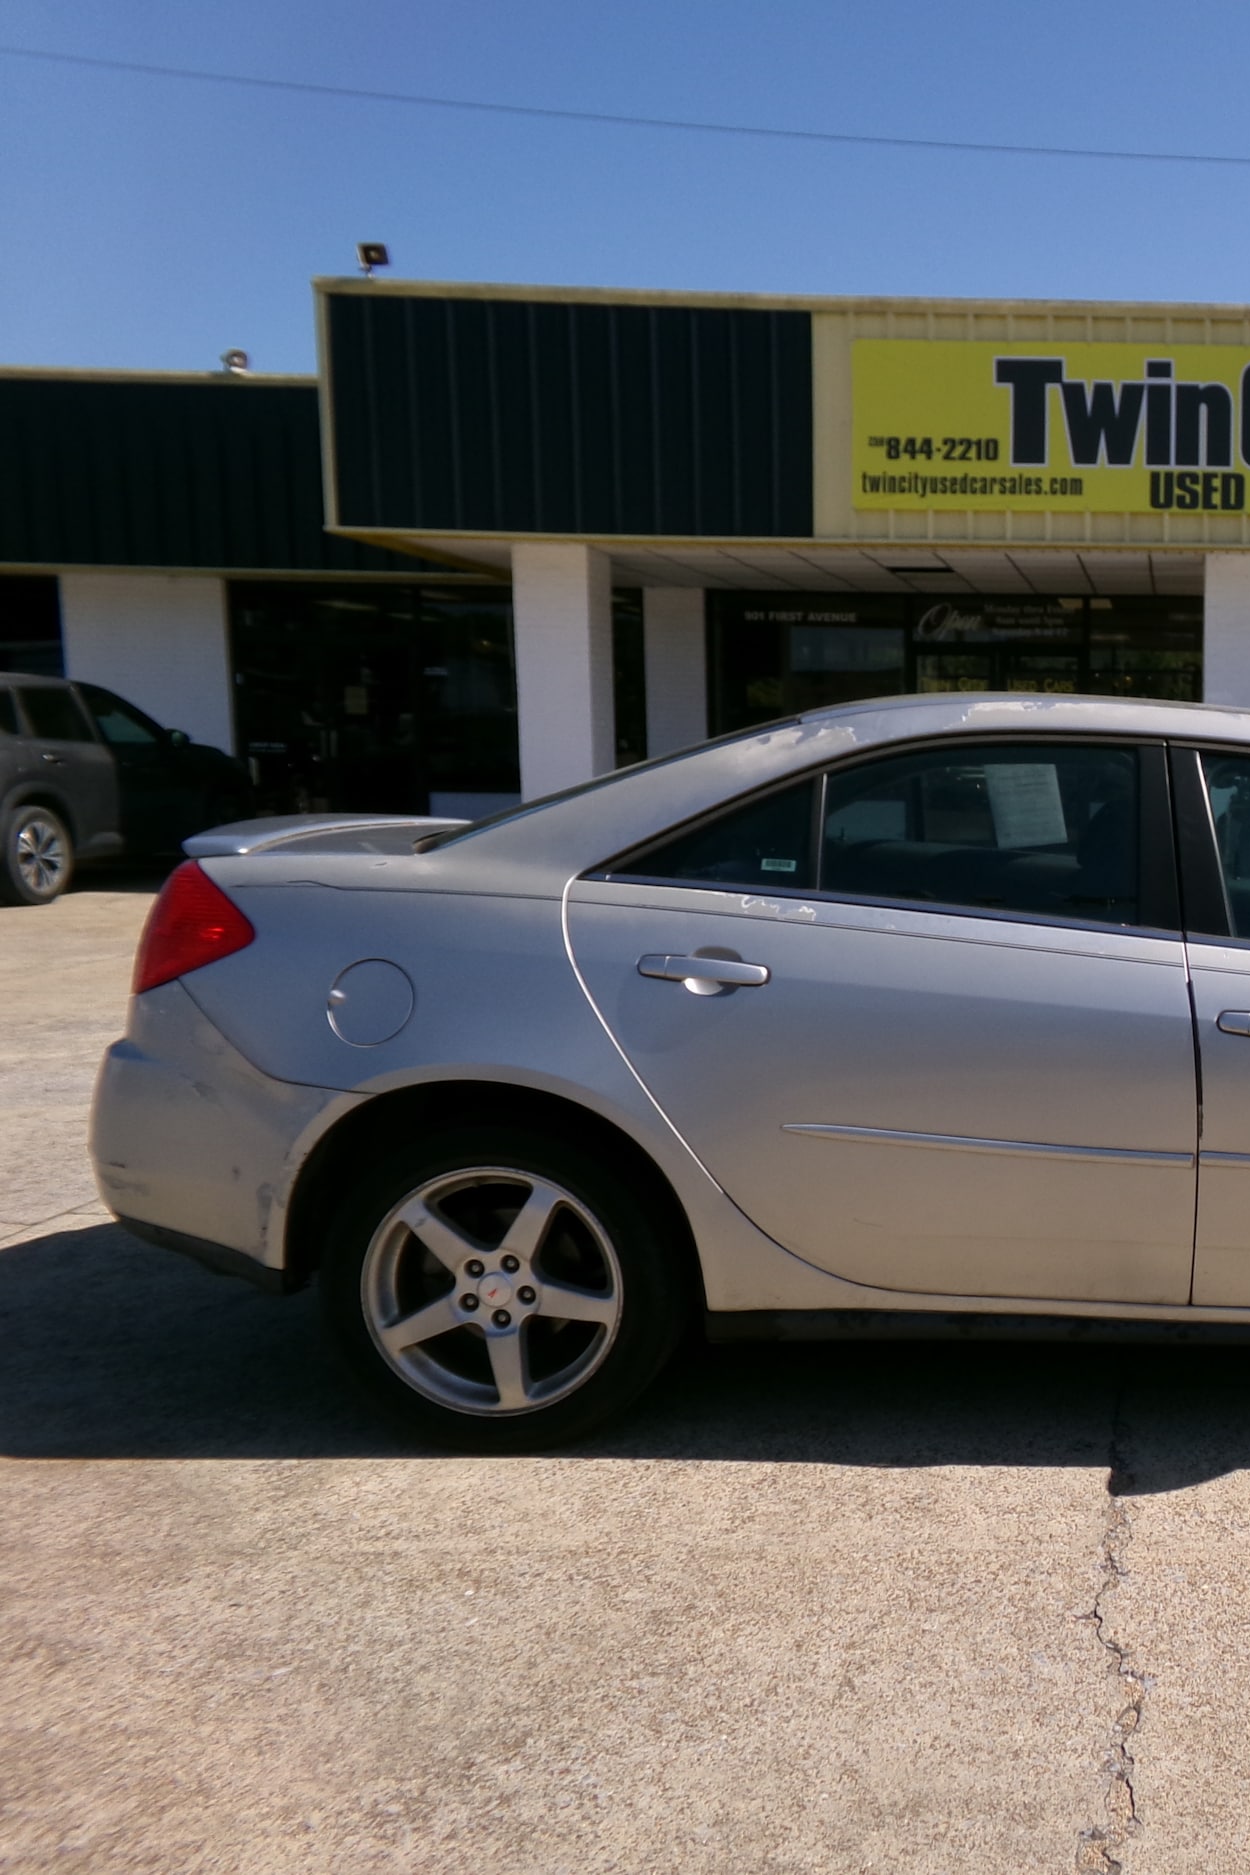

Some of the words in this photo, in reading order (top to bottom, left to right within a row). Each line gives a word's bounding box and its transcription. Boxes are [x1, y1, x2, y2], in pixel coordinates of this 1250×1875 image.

[861, 472, 1083, 498] twincityusedcarsales.com
[1149, 471, 1245, 511] USED
[768, 611, 804, 622] FIRST
[807, 612, 857, 623] AVENUE
[917, 602, 982, 640] Open
